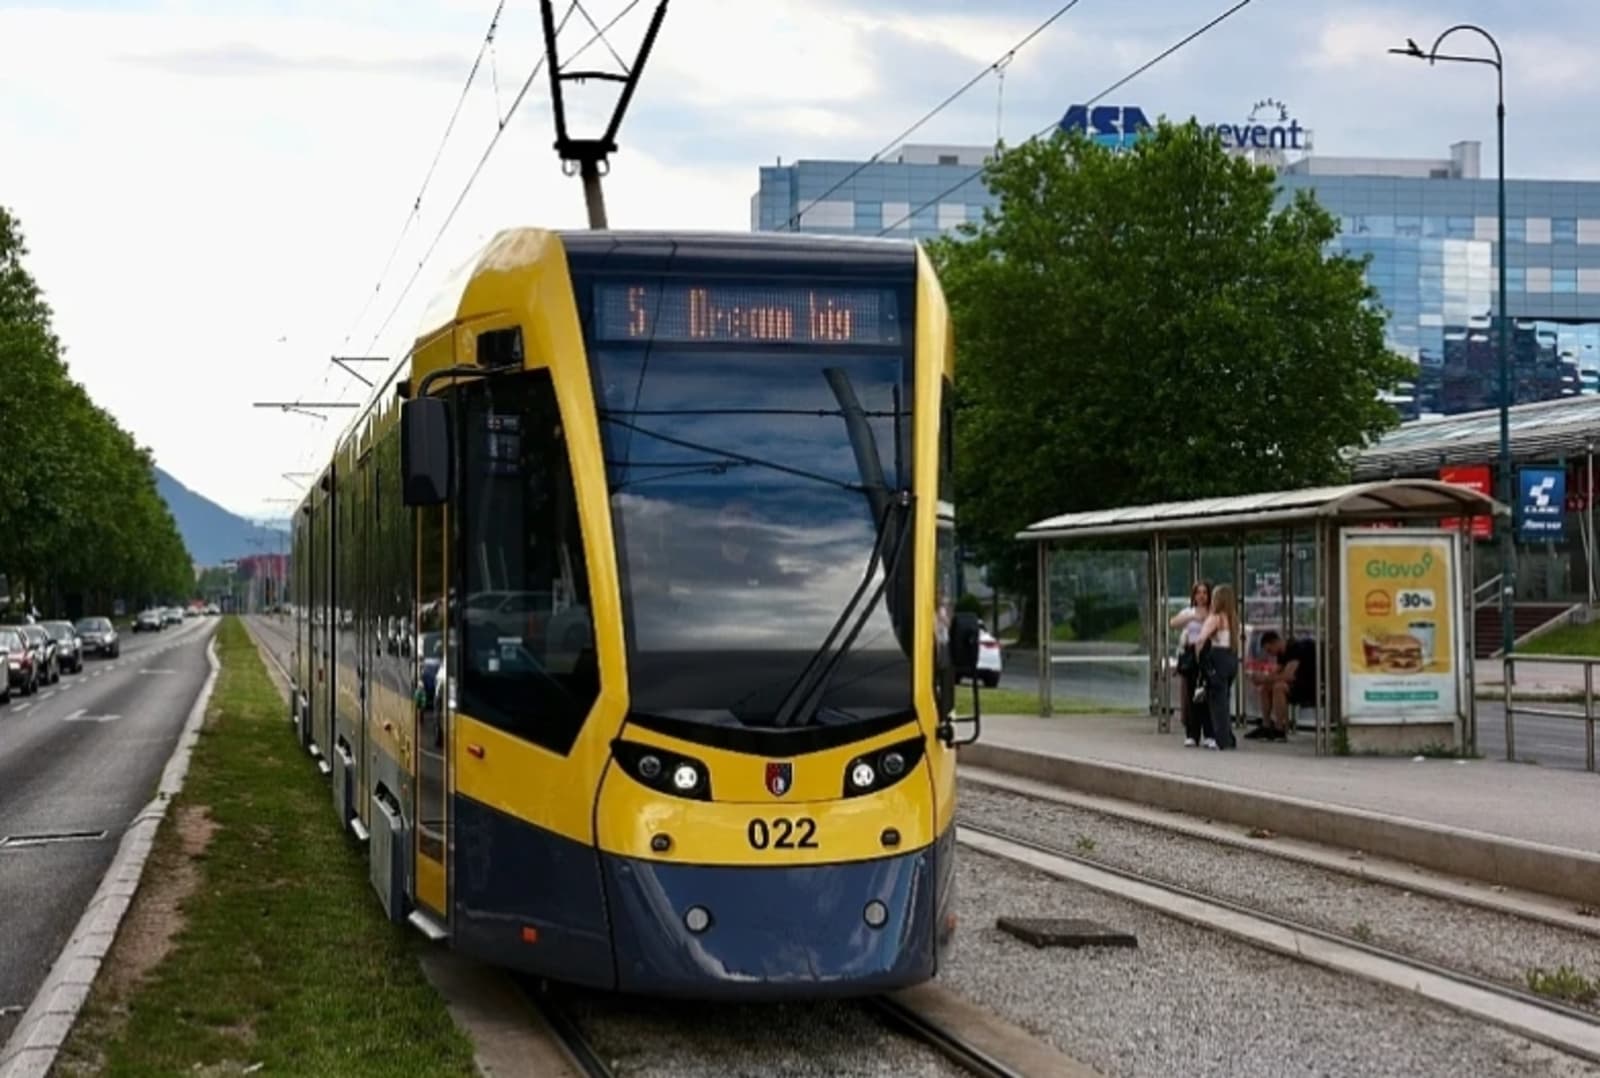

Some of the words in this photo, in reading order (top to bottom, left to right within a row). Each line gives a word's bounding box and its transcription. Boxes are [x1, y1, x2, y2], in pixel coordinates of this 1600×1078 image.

[1190, 119, 1303, 149] revent
[1365, 558, 1428, 579] Glovo
[747, 817, 819, 851] 022
